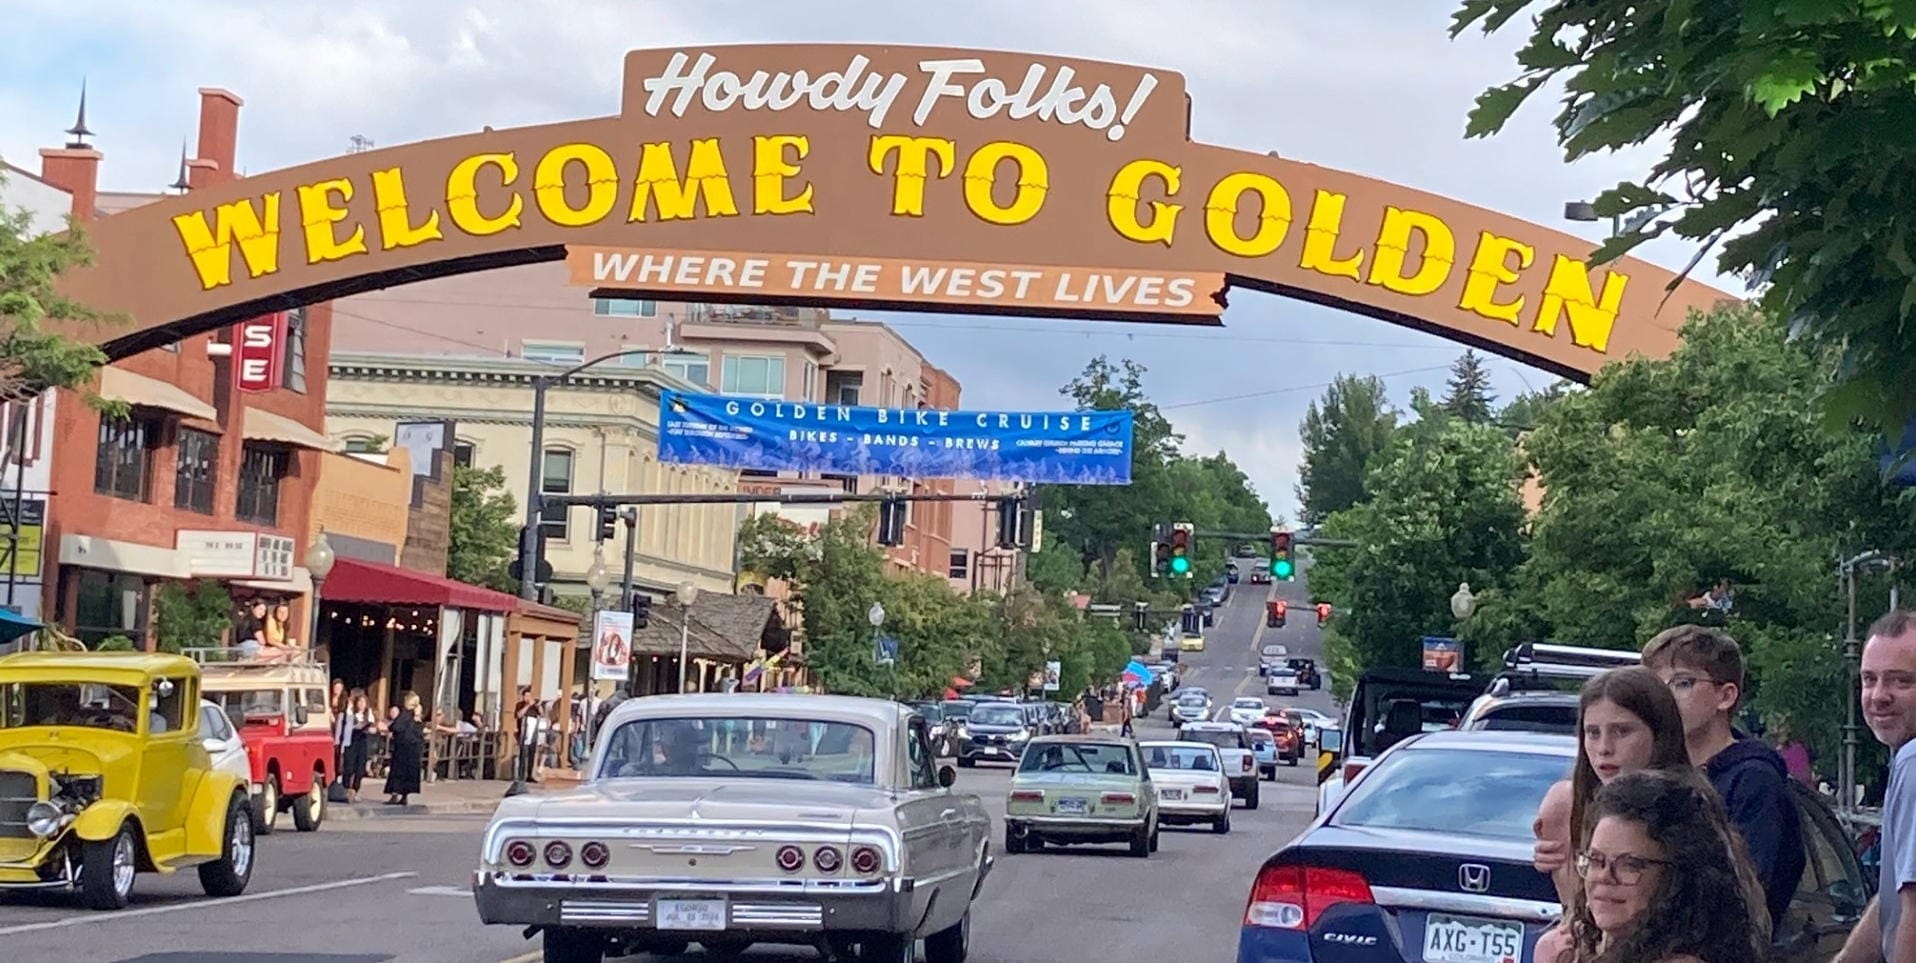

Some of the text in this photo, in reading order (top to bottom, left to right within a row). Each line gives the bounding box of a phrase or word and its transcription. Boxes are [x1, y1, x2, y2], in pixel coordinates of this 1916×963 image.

[644, 51, 1157, 141] Howdy Folks!
[173, 135, 1630, 353] WELCOME TO GOLDEN
[592, 252, 1196, 307] WHERE THE WEST LIVES
[726, 401, 1092, 431] GOLDEN BIKE CRUISE
[789, 430, 838, 443] BIKES
[863, 434, 919, 446] BANDS
[945, 436, 1000, 450] BREWS
[1323, 932, 1378, 946] CIVIC
